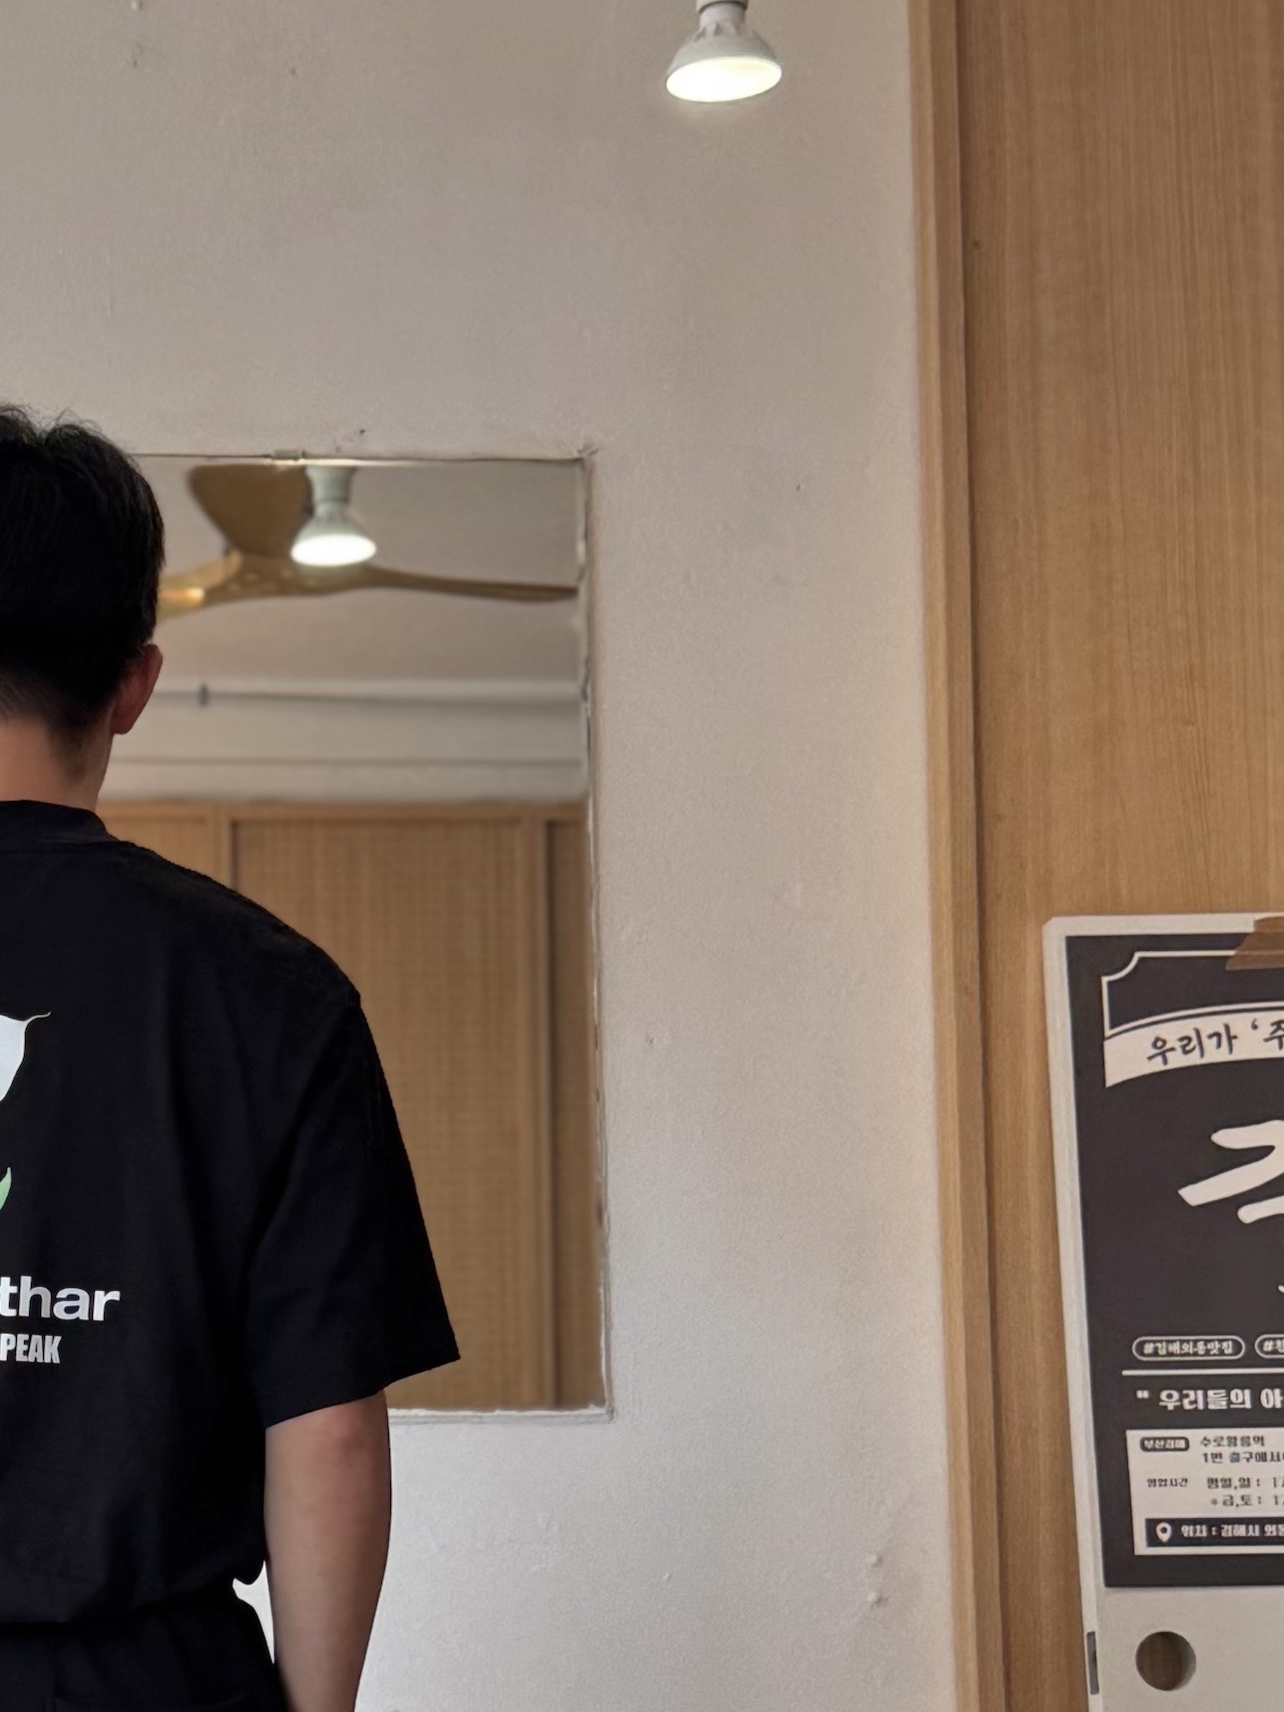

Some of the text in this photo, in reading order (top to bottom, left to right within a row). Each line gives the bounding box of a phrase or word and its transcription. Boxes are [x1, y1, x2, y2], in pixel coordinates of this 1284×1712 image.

[1147, 1023, 1238, 1066] 우리가
[1159, 1388, 1252, 1410] 우리들의
[1260, 1388, 1284, 1409] 아
[1202, 1451, 1284, 1464] 1번 출구에서
[1147, 1478, 1188, 1488] 영업시간
[1181, 1524, 1207, 1537] 위치
[1221, 1524, 1259, 1537] 김해시
